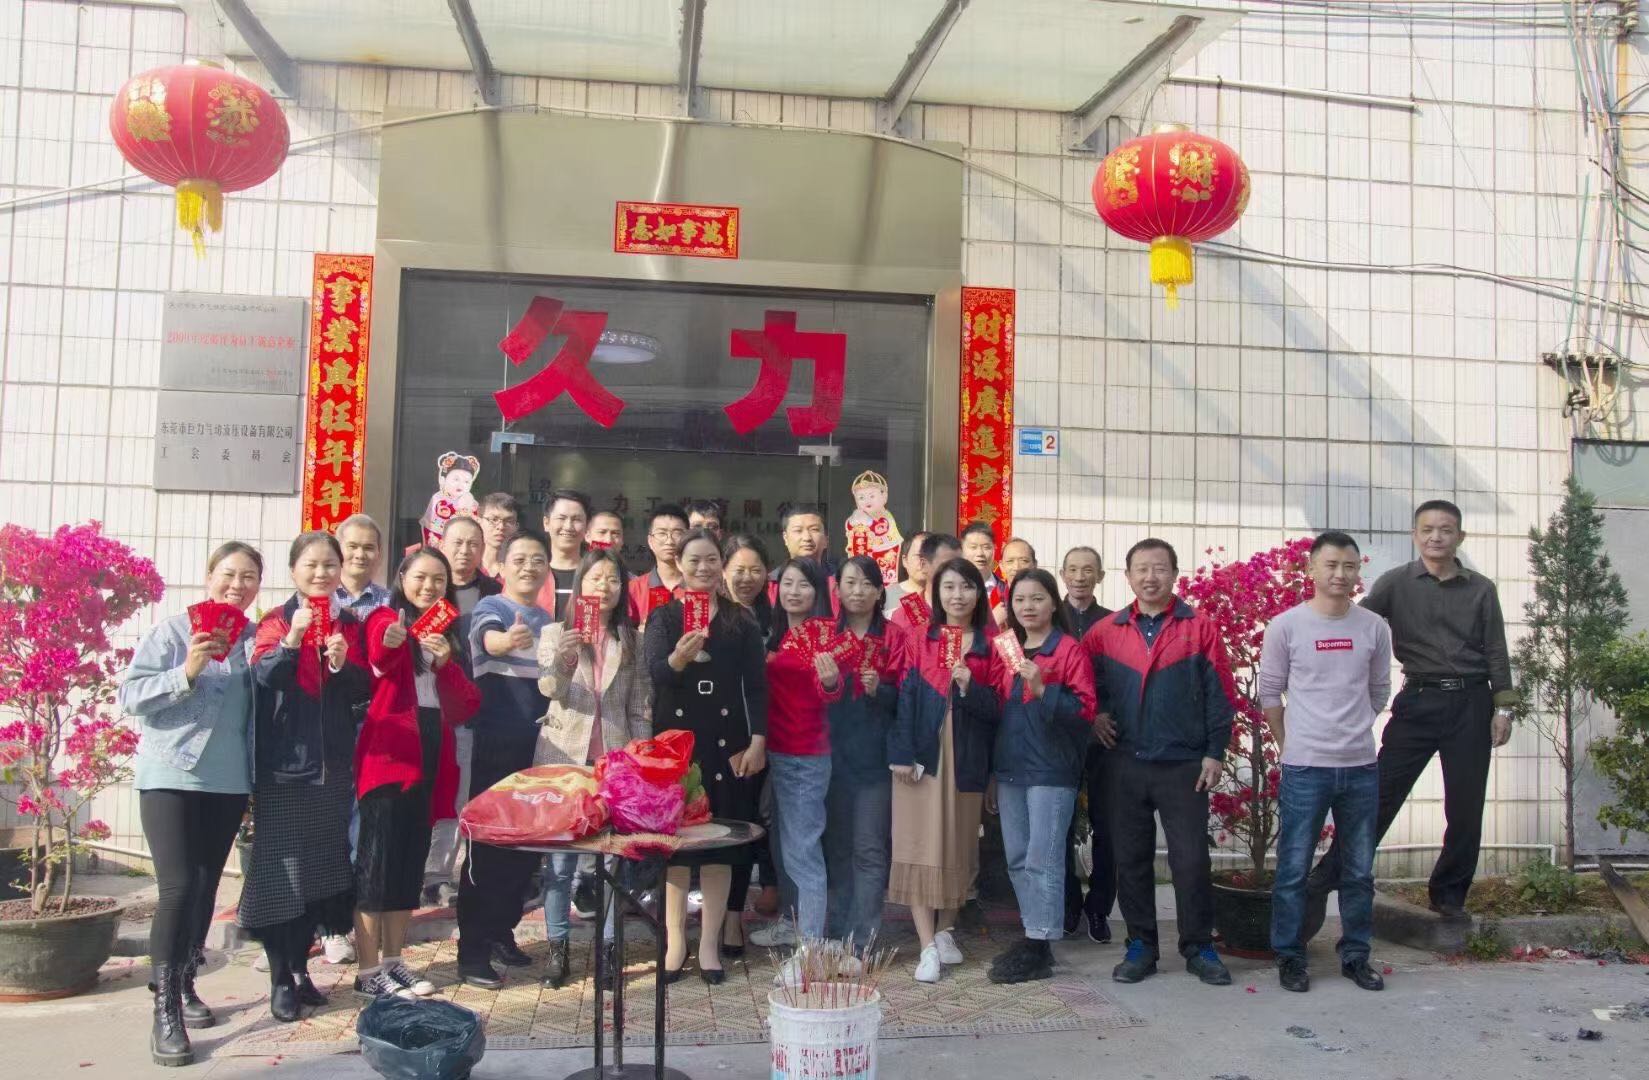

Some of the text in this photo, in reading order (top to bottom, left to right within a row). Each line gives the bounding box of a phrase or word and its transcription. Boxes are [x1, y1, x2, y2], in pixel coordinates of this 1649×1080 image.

[493, 295, 847, 437] 久力
[1045, 435, 1056, 450] 2
[1318, 640, 1351, 648] Superman
